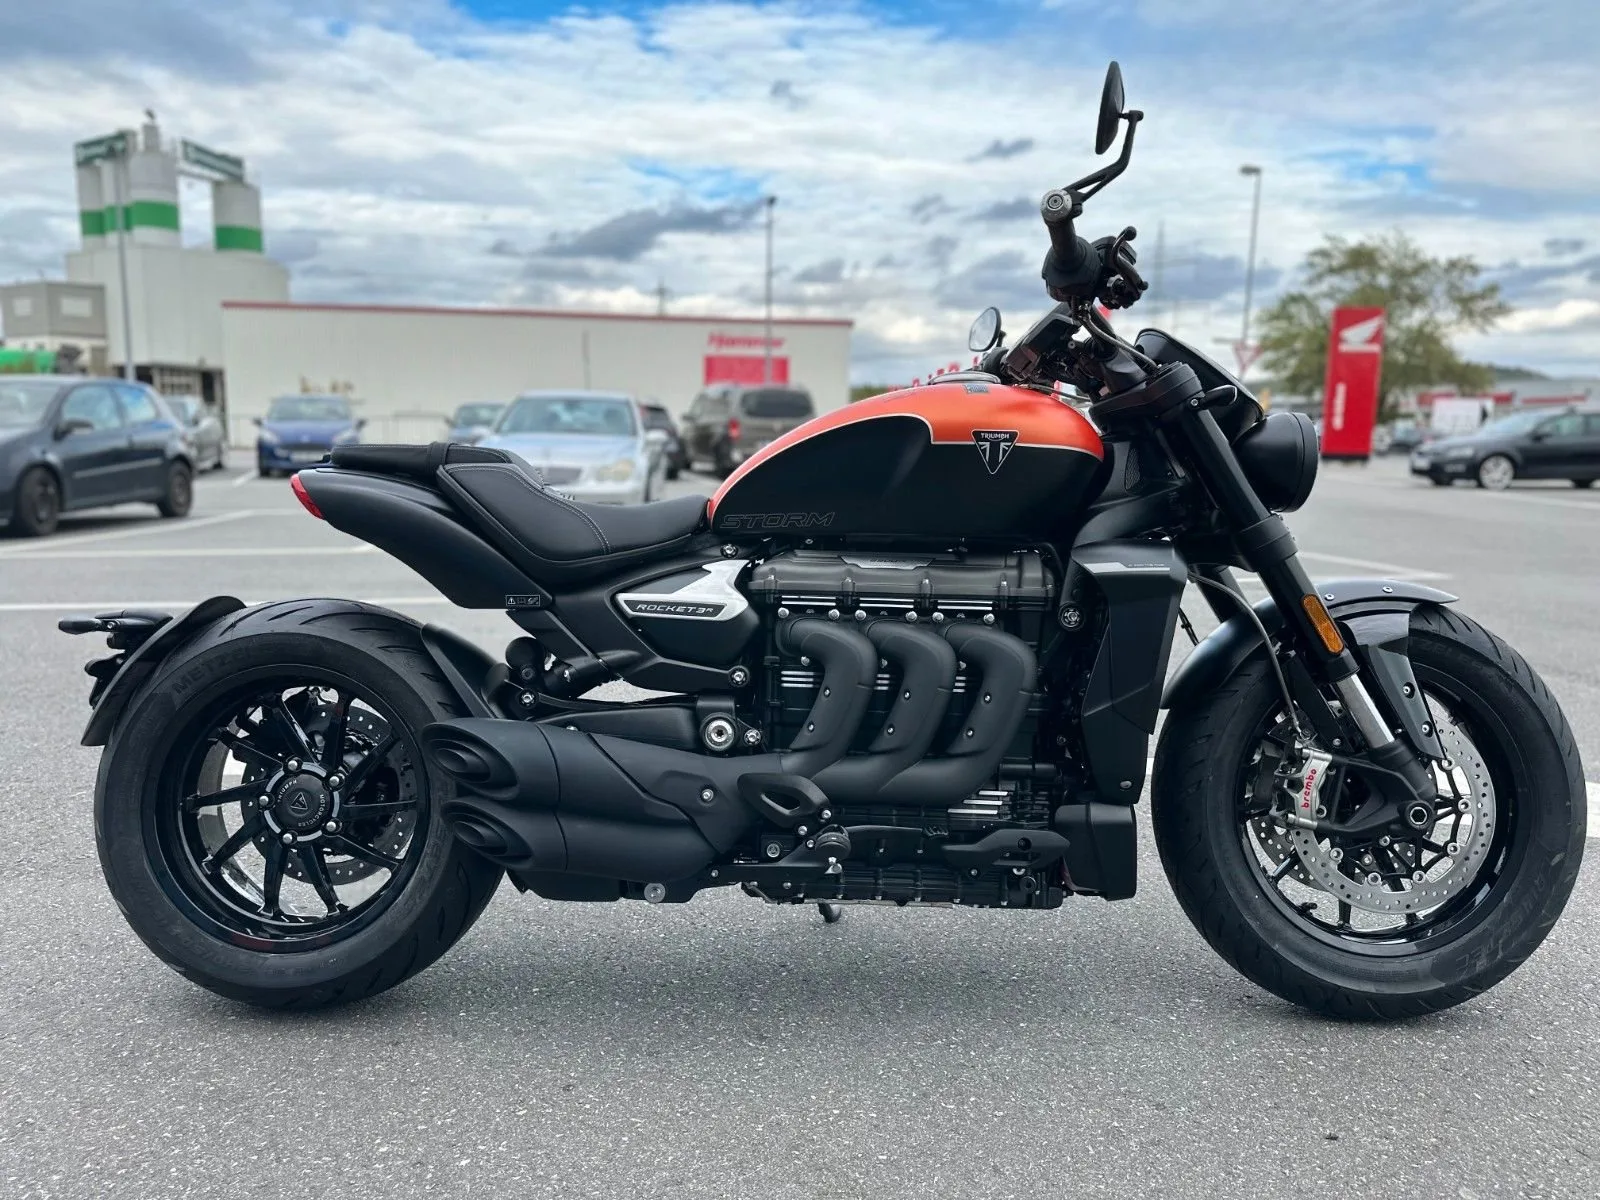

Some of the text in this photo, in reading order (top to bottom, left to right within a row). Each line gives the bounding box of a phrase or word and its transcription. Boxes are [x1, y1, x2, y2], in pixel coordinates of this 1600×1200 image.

[980, 432, 1010, 440] TRIUMPH
[720, 511, 836, 529] STORM
[277, 779, 297, 803] TRIUMPH
[1300, 768, 1317, 809] brembo
[297, 794, 326, 827] MOTORCYCLES
